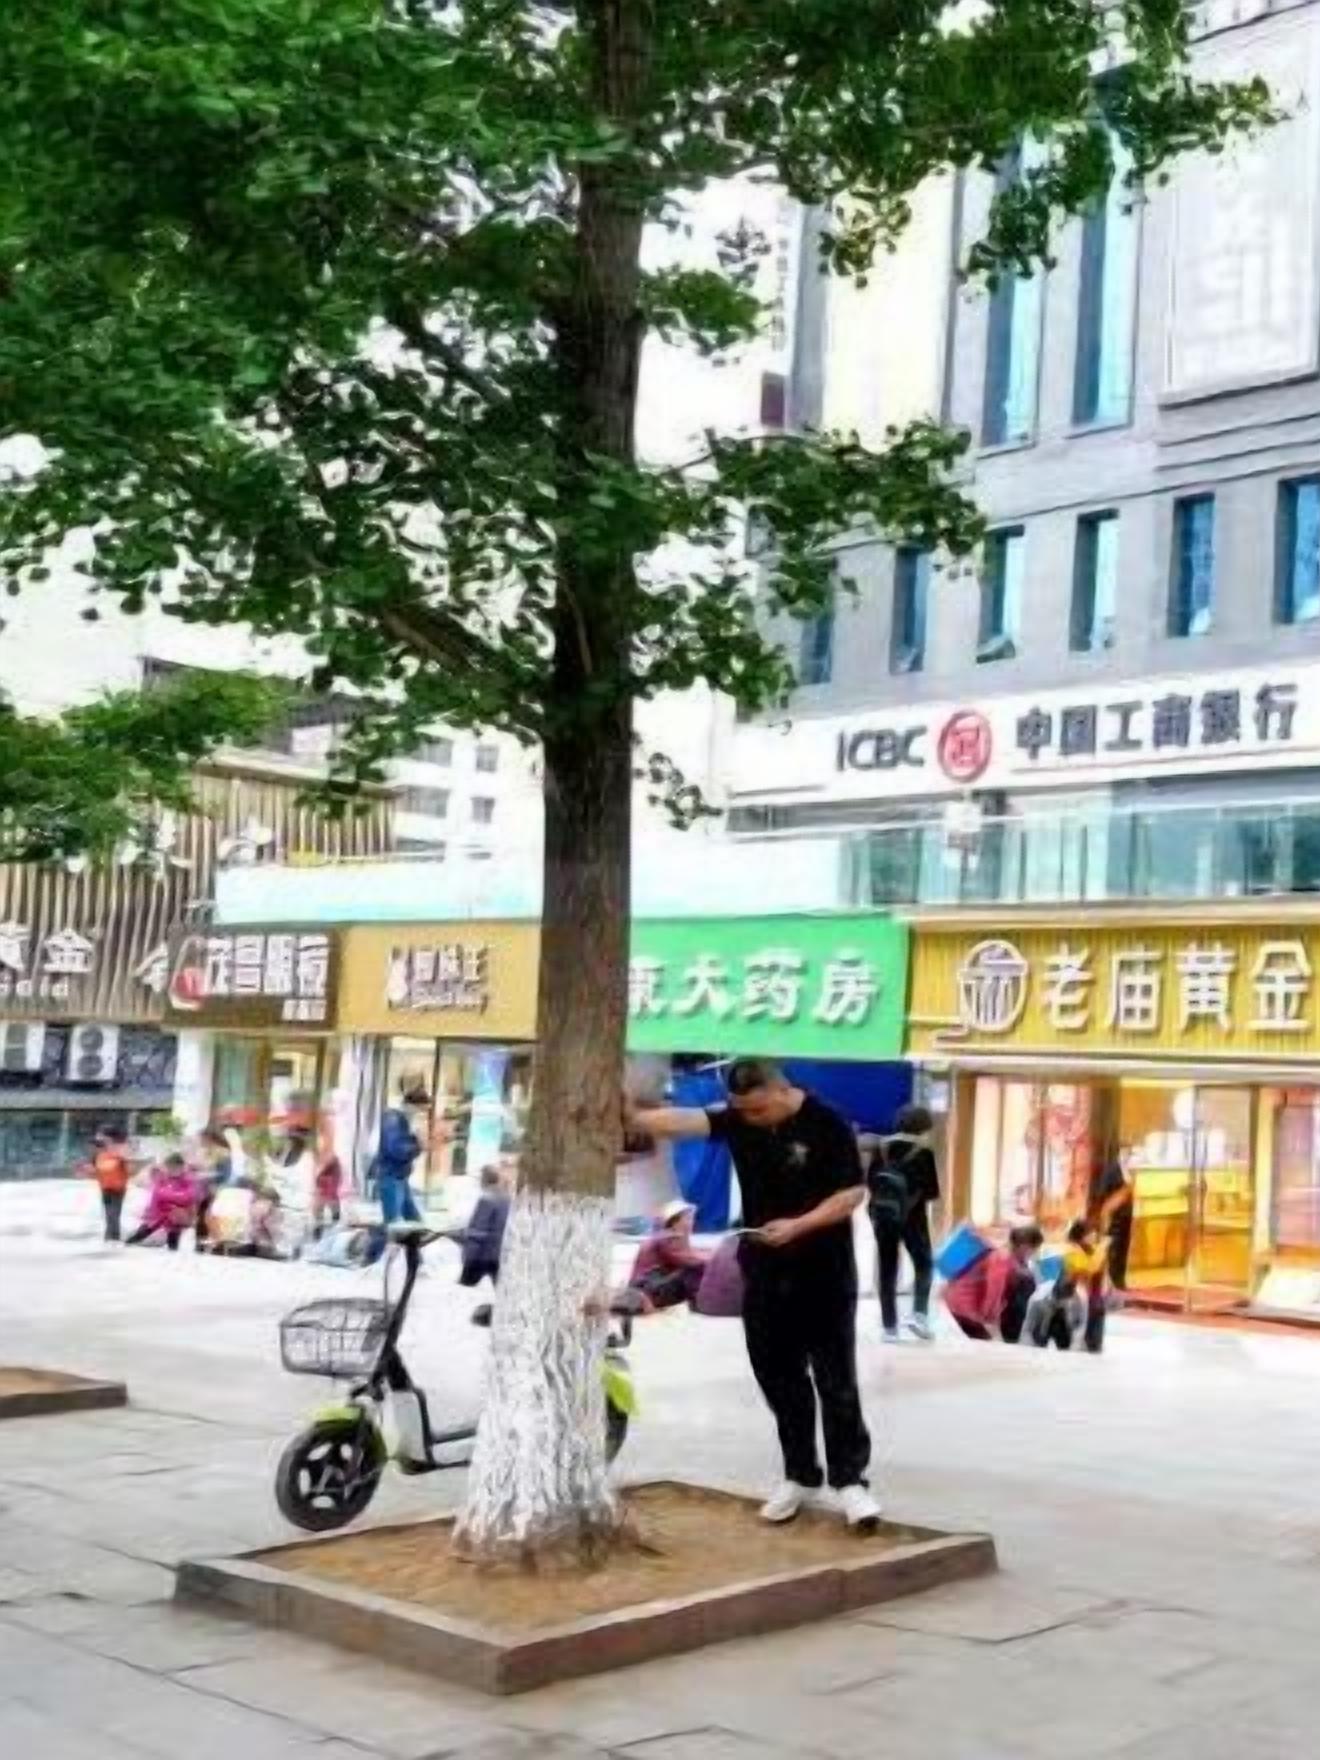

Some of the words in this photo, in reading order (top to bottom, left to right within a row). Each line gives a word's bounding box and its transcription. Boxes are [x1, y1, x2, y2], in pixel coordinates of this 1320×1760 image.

[835, 726, 927, 772] ICBC
[1015, 684, 1298, 760] 中国工商银行
[1041, 940, 1313, 1033] 老庙黄金
